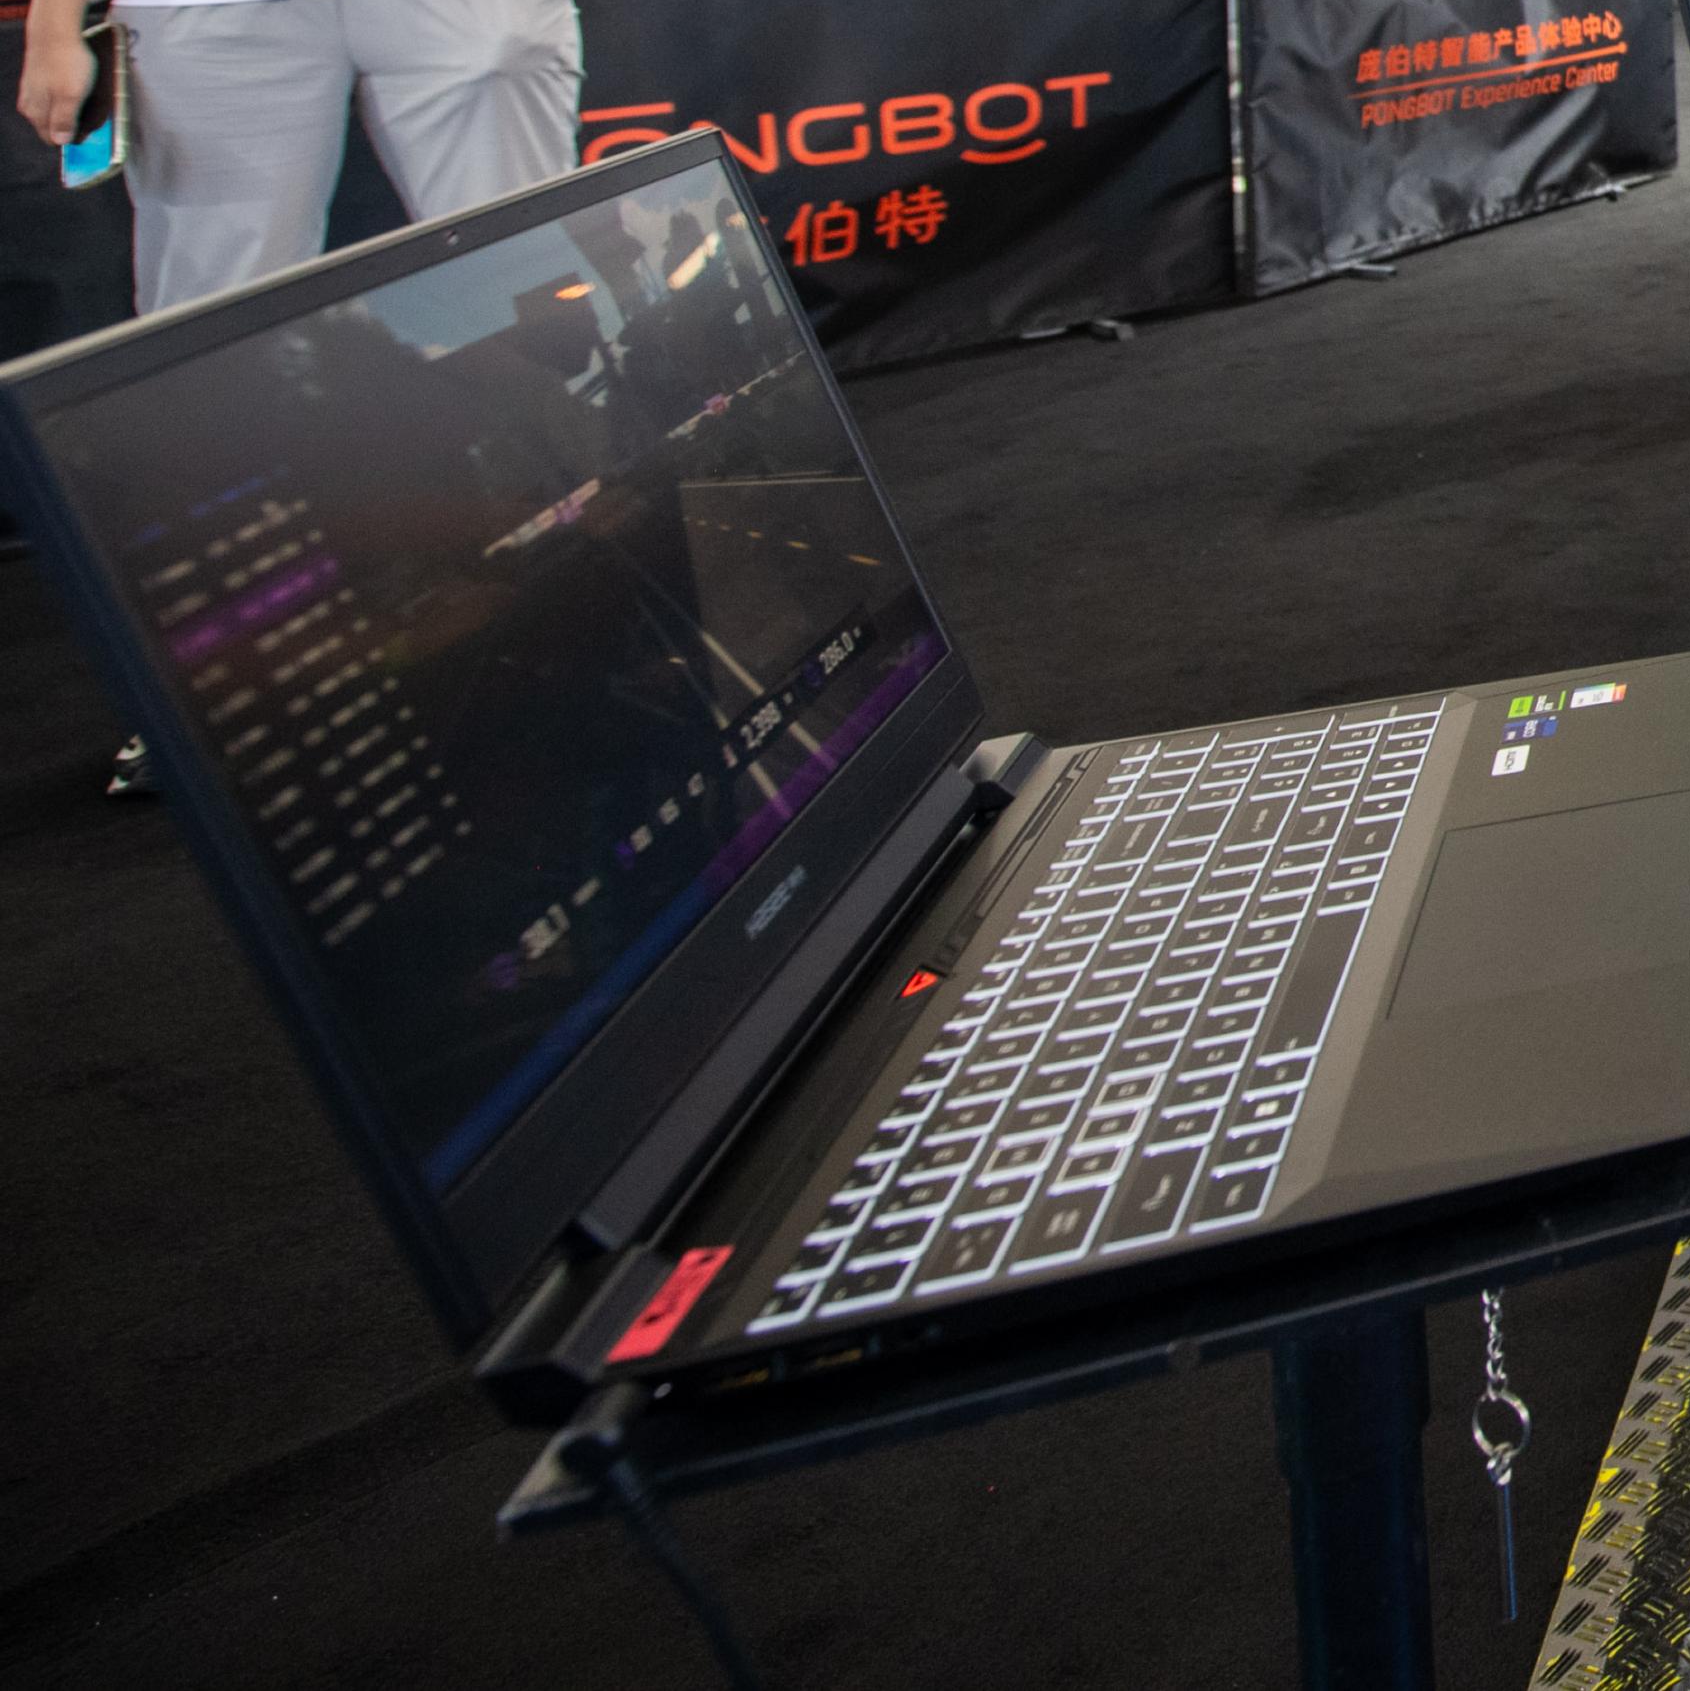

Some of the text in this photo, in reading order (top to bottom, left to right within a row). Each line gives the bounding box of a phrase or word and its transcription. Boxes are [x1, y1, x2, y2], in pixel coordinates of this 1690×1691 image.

[1355, 11, 1623, 84] 庞伯特智能产品体验中心
[1361, 61, 1620, 129] PONGBOT Experience Center
[782, 186, 949, 267] 伯特
